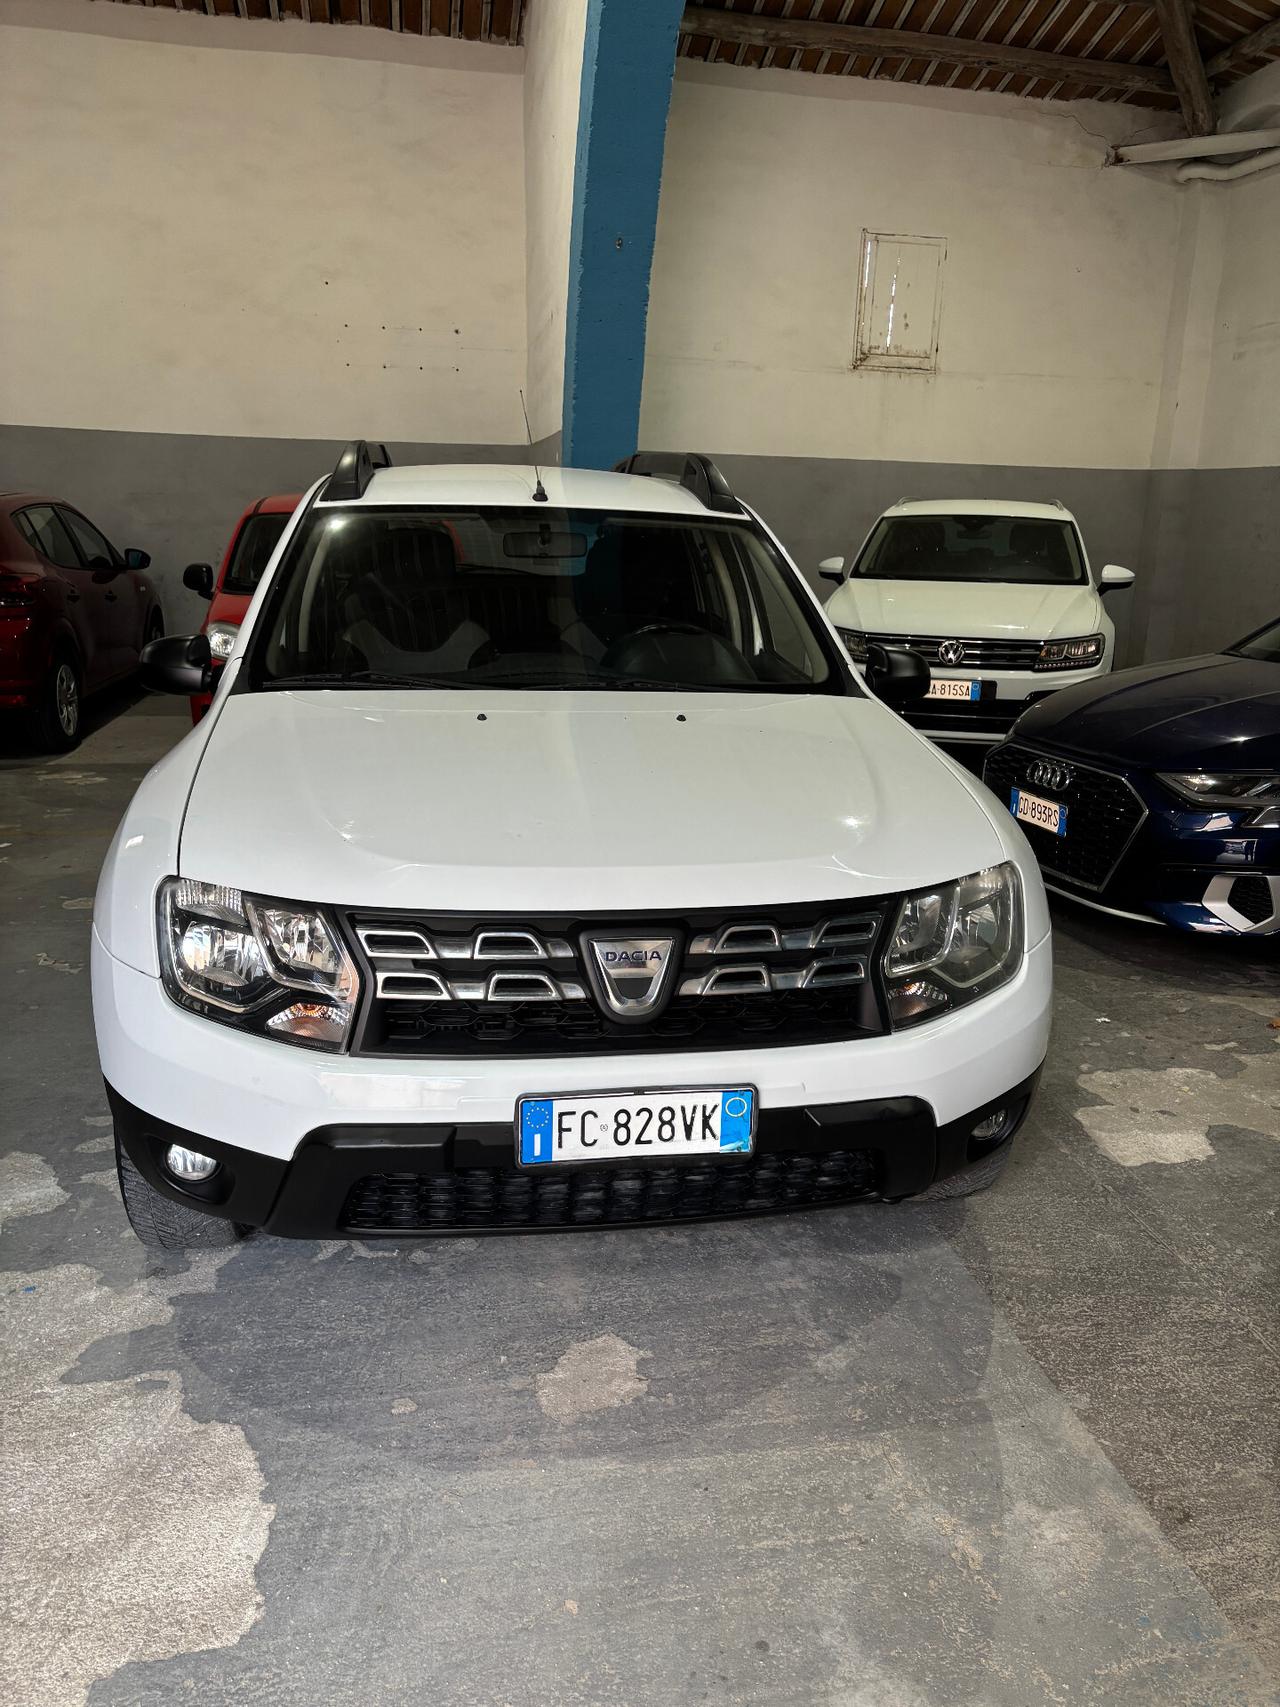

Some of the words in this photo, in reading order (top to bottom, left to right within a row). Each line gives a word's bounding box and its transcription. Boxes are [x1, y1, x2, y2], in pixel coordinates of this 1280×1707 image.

[940, 684, 970, 696] 815SA
[1031, 802, 1059, 827] 893RS
[605, 951, 662, 962] DACIA
[557, 1110, 599, 1149] FC
[613, 1103, 720, 1146] 828VK
